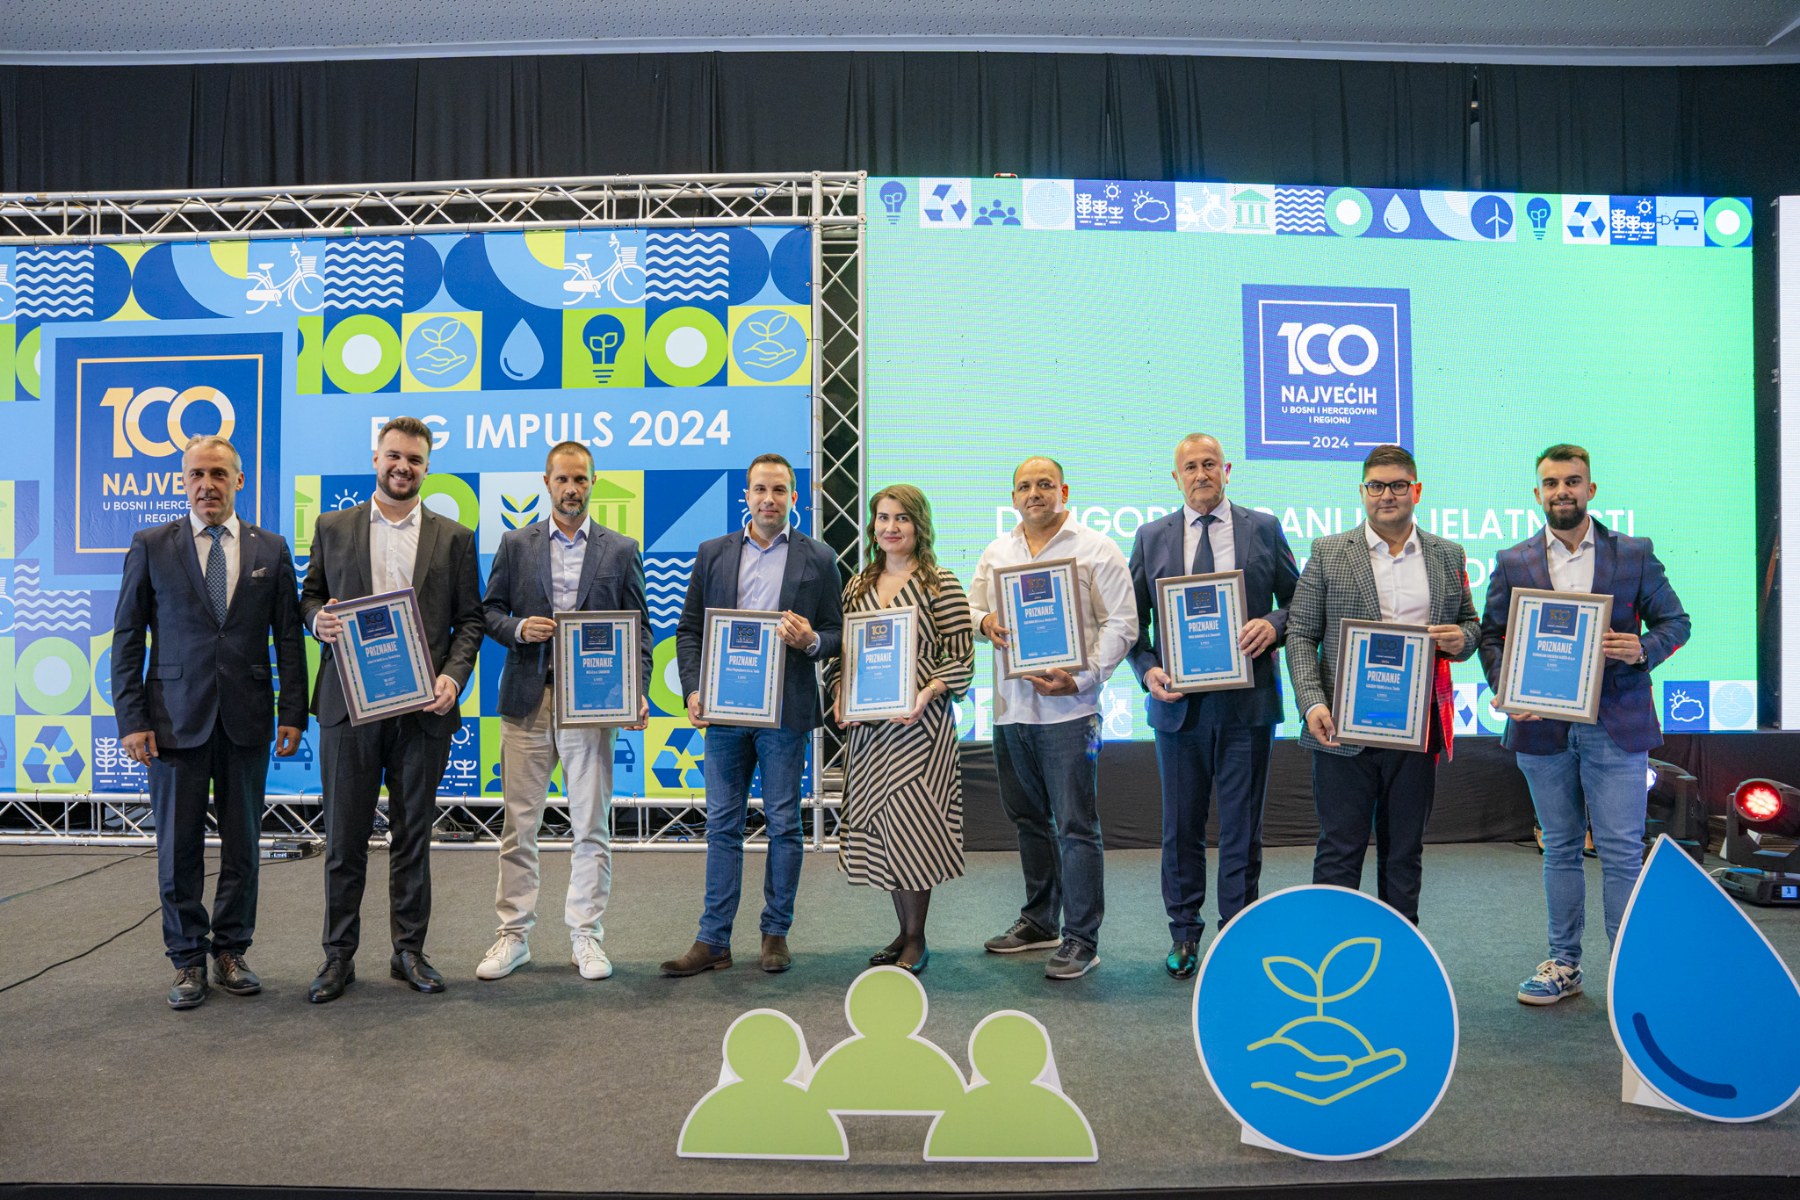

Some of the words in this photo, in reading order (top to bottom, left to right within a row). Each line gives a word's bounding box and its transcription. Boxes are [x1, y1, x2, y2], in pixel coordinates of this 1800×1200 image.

[1277, 322, 1379, 376] 100
[1281, 382, 1378, 404] NAJVEĆIH
[1290, 406, 1315, 414] BOSNI
[1322, 407, 1378, 415] HERCEGOVINI
[99, 385, 236, 458] 100
[1313, 416, 1351, 424] REGIONU
[466, 411, 614, 449] IMPULS
[628, 409, 731, 446] 2024
[1312, 436, 1350, 448] 2024
[102, 472, 187, 496] NAJVE
[103, 501, 111, 510] U
[113, 501, 146, 510] BOSNI
[150, 501, 153, 510] I
[138, 514, 142, 523] I
[1024, 605, 1055, 618] PRIZNANJE
[1187, 620, 1220, 632] PRIZNANJE
[365, 641, 398, 657] PRIZNANJE
[1537, 640, 1573, 654] PRIZNANJE
[582, 657, 613, 668] PRIZNANJE
[728, 655, 758, 667] PRIZNANJE
[865, 652, 892, 663] PRIZNANJE
[1367, 670, 1400, 684] PRIZNANJE
